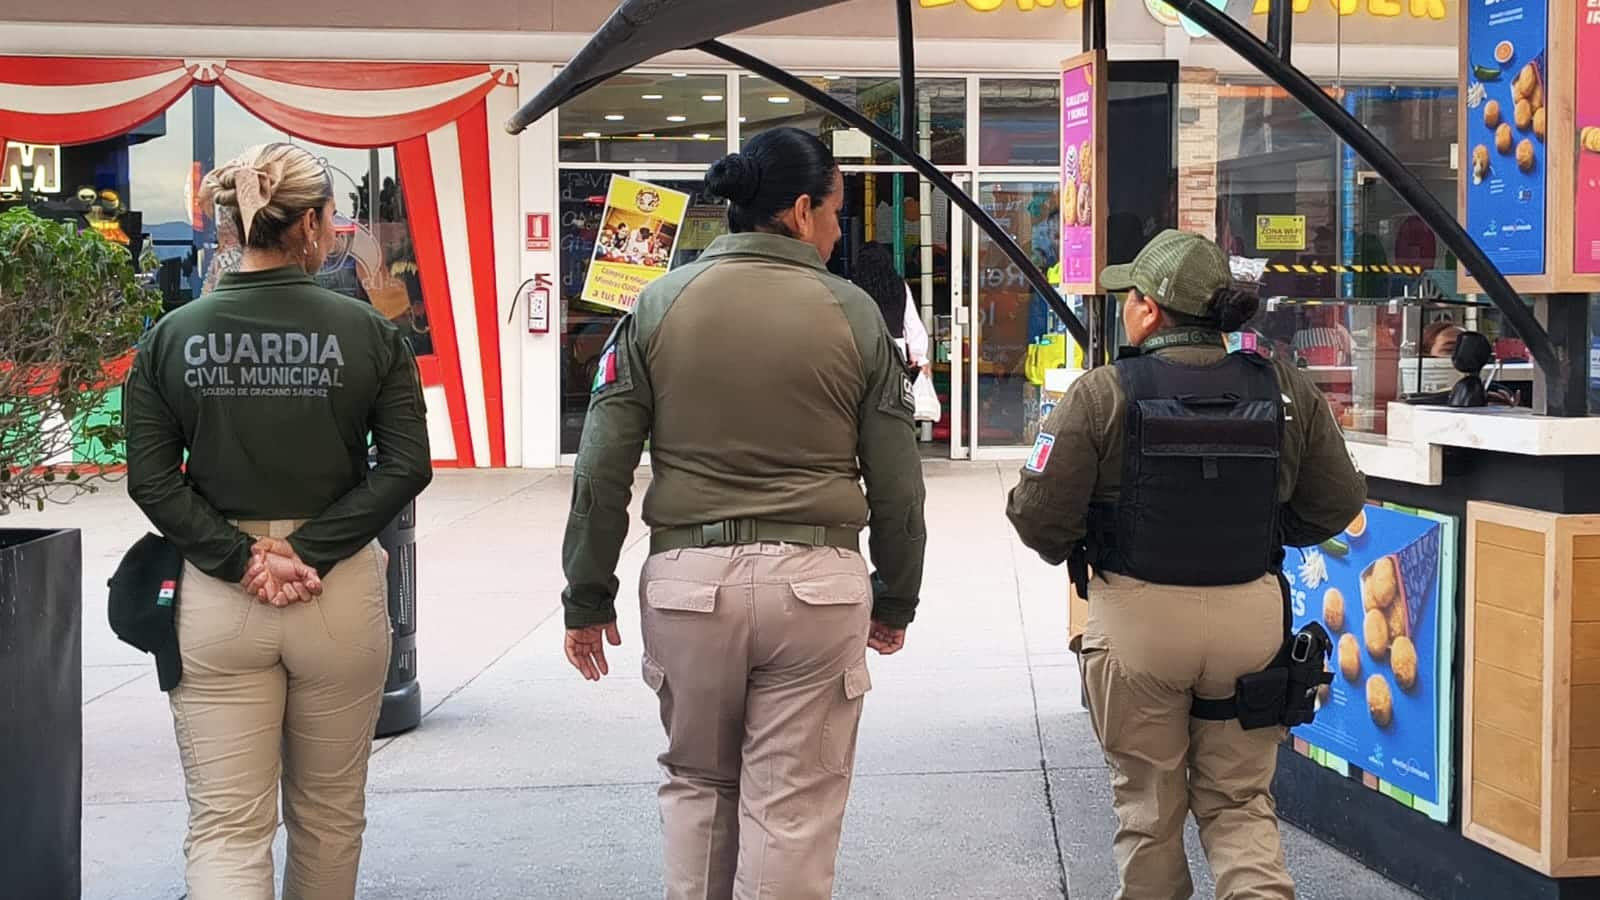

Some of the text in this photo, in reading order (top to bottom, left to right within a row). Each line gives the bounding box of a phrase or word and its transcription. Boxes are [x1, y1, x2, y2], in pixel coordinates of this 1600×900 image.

[184, 332, 345, 366] GUARDIA
[184, 366, 344, 388] CIVIL MUNICIPAL
[202, 387, 236, 397] SOLEDAD
[237, 387, 248, 396] DE
[249, 387, 291, 397] GRACIANO
